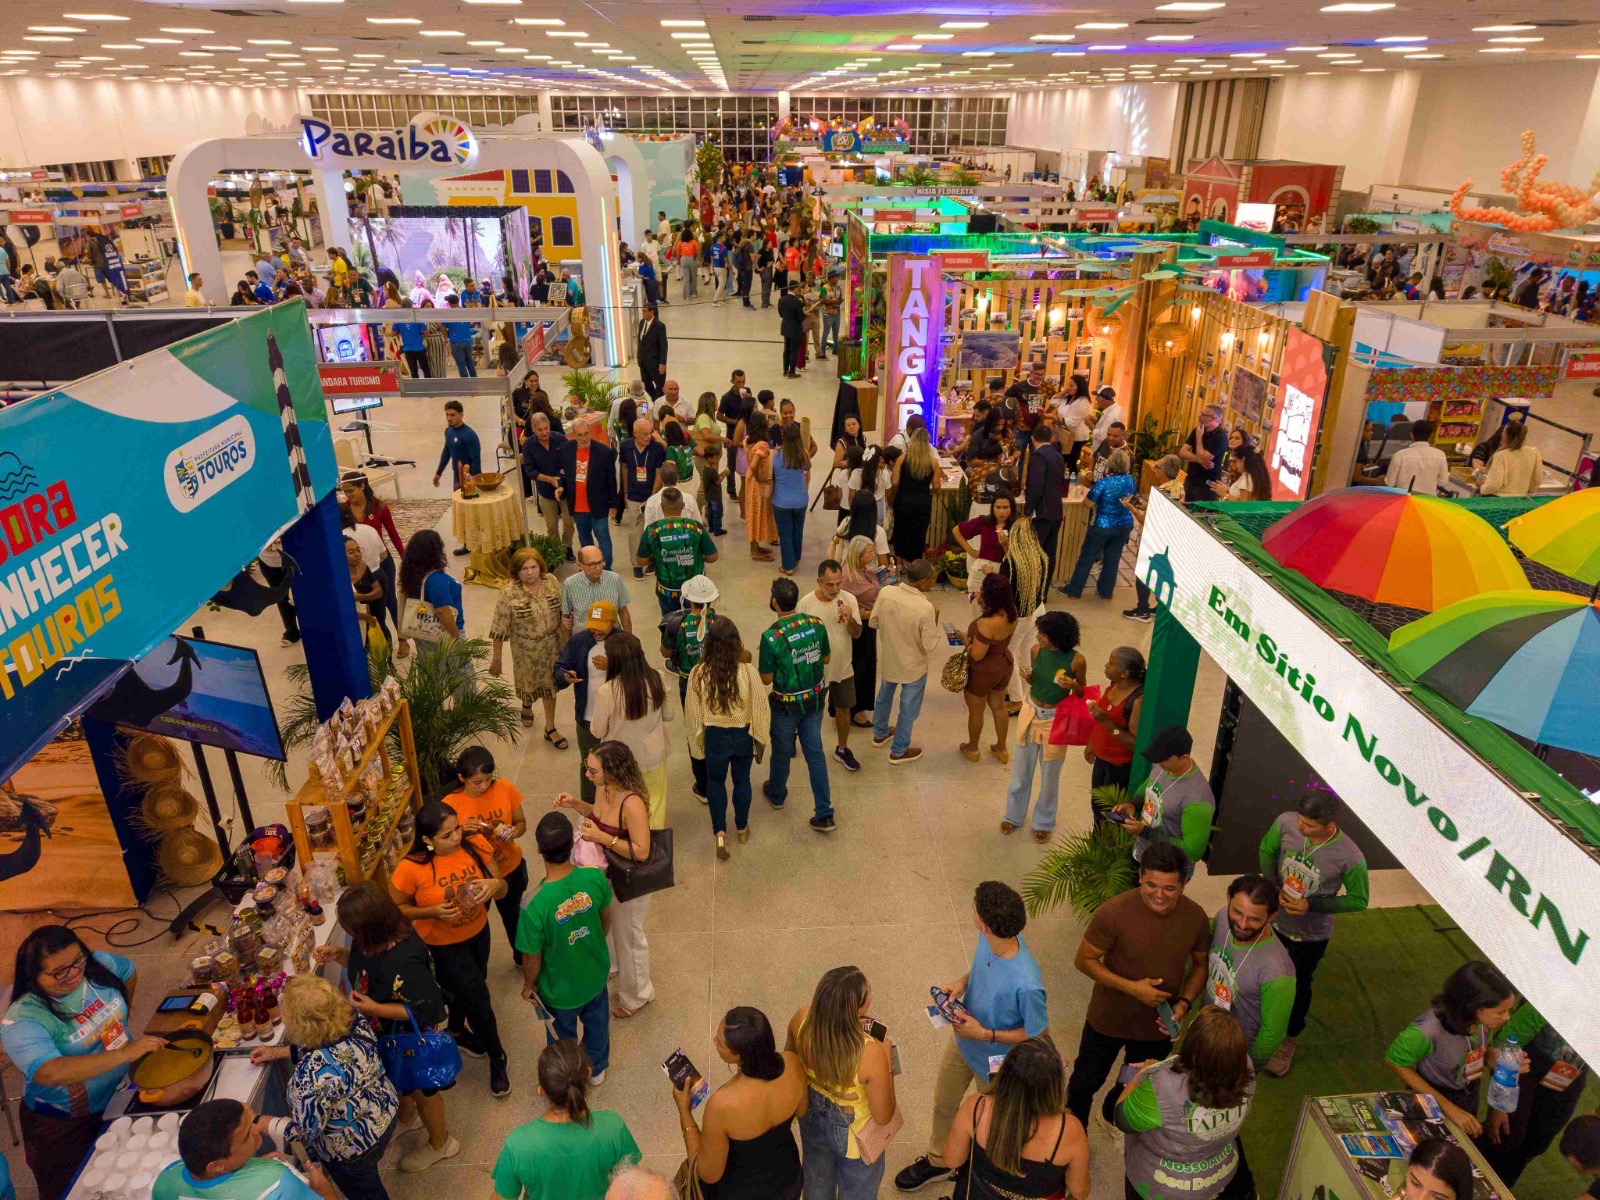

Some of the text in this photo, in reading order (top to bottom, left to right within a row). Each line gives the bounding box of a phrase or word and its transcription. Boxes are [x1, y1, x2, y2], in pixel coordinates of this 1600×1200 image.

[300, 118, 453, 163] Paraíba
[348, 375, 380, 386] TURISMO
[194, 430, 243, 463] PREFEITURA MUNICIPAL
[197, 440, 247, 485] TOUROS
[0, 479, 78, 566] ORA
[0, 512, 129, 637] NHECER
[1208, 584, 1251, 643] Em
[438, 865, 476, 888] CAJU
[1160, 1158, 1208, 1174] NOSSO
